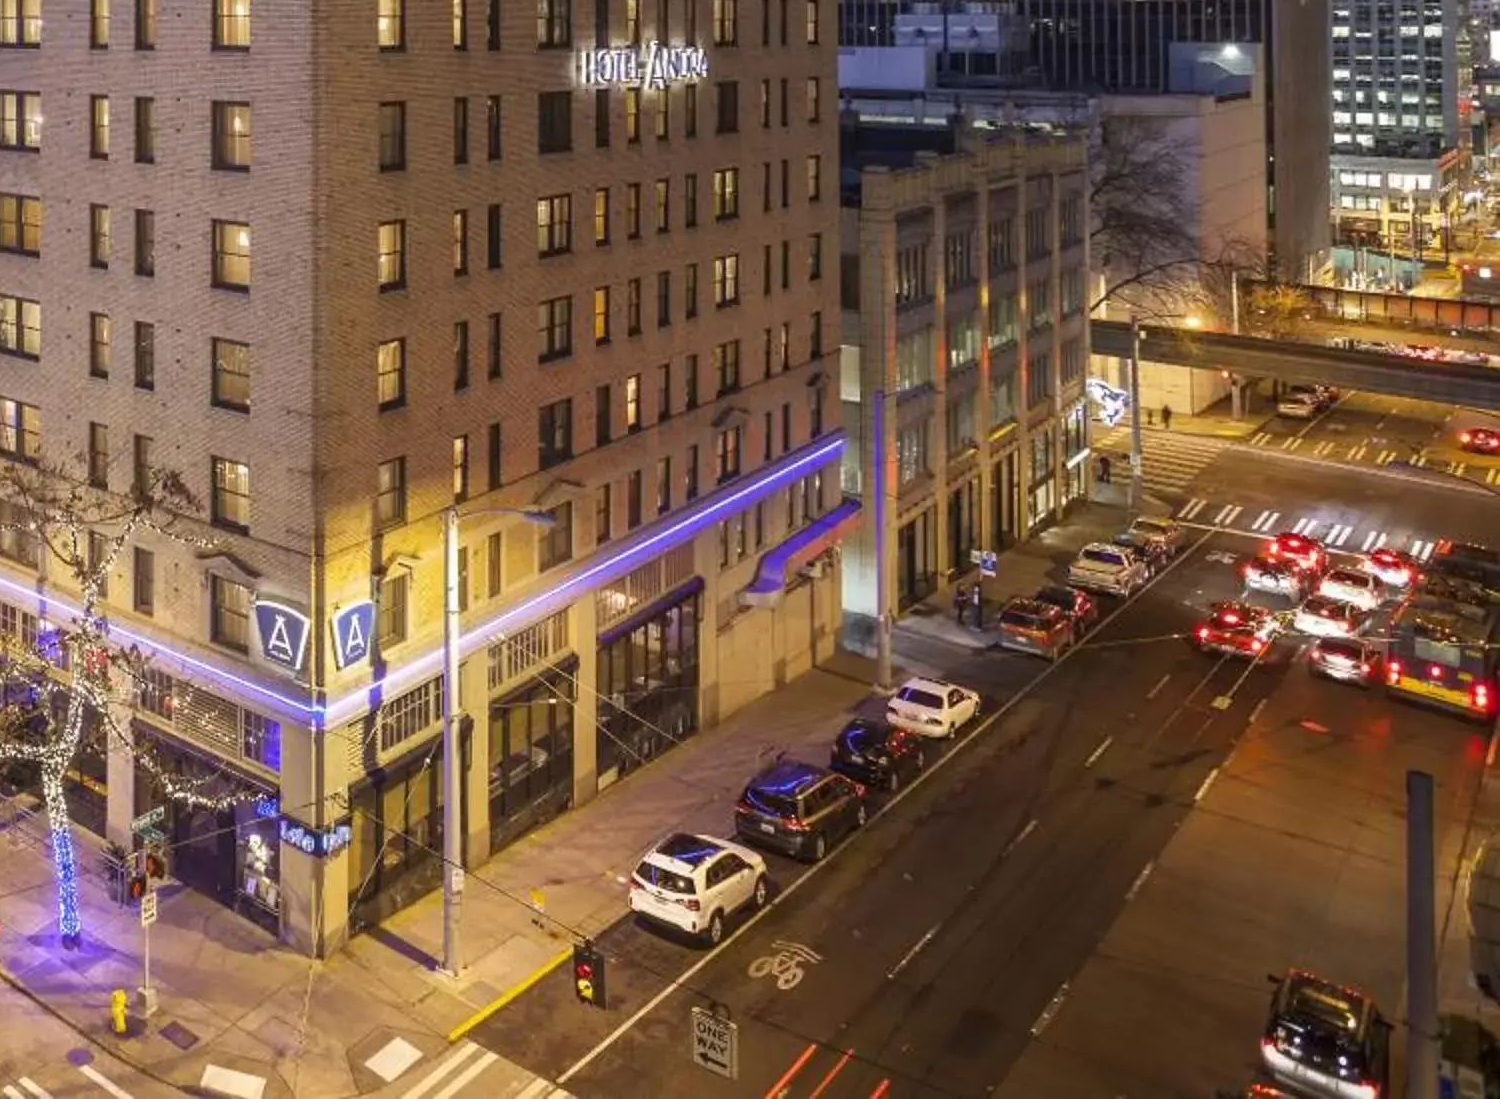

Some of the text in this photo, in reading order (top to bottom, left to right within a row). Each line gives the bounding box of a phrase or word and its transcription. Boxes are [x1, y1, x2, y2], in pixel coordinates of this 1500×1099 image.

[580, 48, 642, 85] HOTEL
[268, 613, 293, 657] A
[345, 613, 365, 655] A
[696, 1021, 728, 1043] ONE
[697, 1037, 728, 1057] WAY
